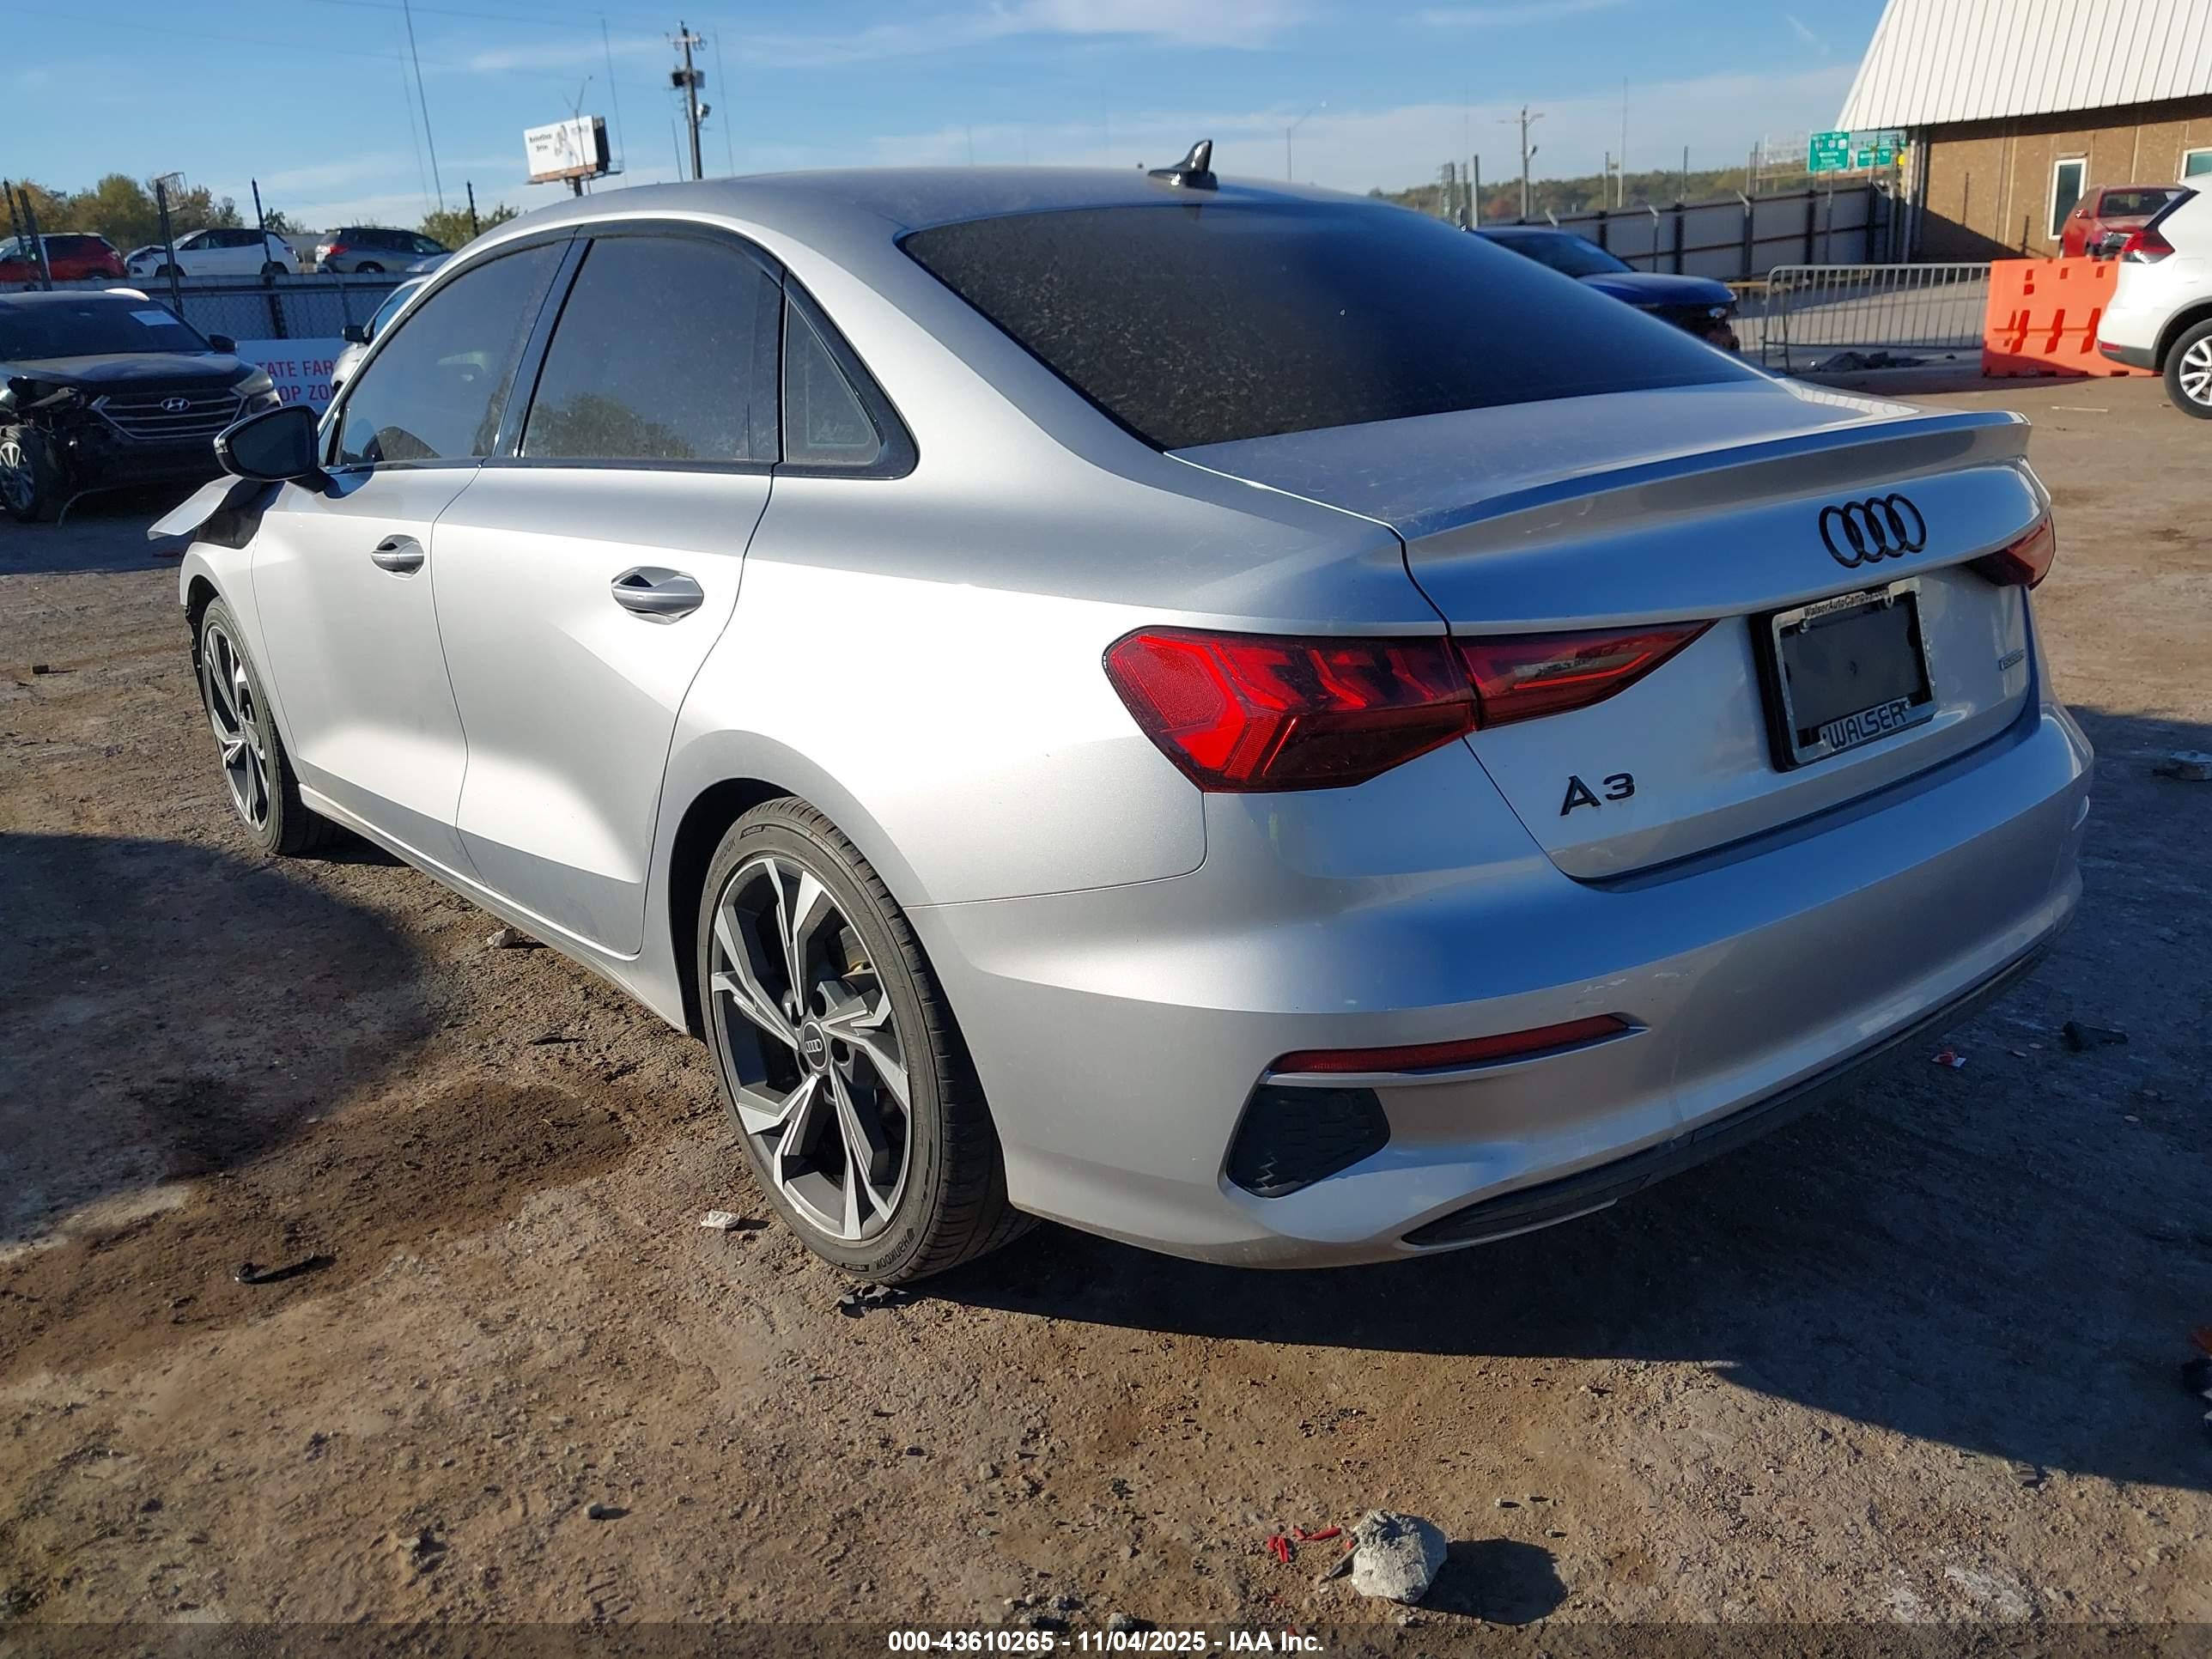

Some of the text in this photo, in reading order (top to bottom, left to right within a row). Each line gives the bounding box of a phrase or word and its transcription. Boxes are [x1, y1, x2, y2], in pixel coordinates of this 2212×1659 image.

[301, 359, 337, 376] FAR
[1827, 702, 1906, 749] WALSER
[1559, 772, 1635, 817] A3
